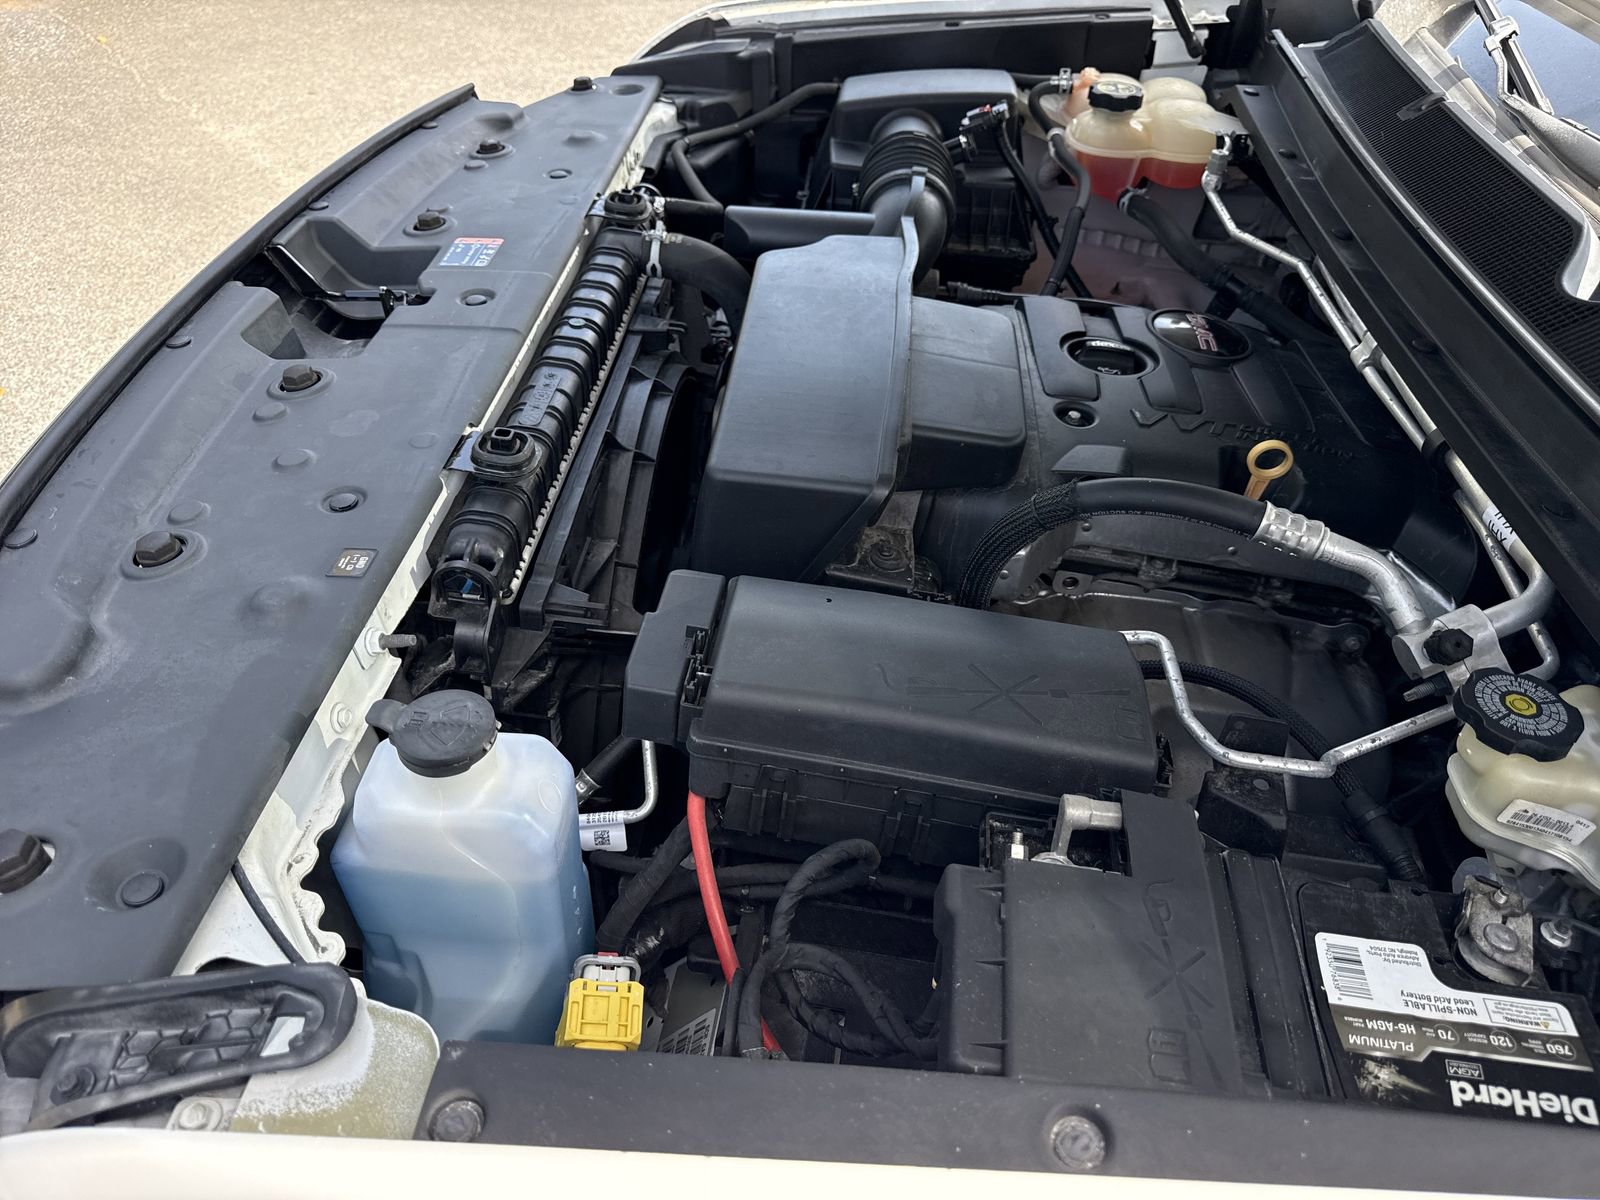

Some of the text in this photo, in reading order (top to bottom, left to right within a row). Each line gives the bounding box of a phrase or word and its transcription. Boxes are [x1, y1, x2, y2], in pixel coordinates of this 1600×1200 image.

[1400, 990, 1475, 1006] Lead Acid Battery
[1402, 998, 1478, 1016] NON-SPILLABLE
[1366, 1018, 1416, 1034] H6-AGM
[1348, 1034, 1415, 1052] PLATINUM
[1437, 1029, 1456, 1041] 70
[1490, 1034, 1513, 1048] 120
[1546, 1043, 1573, 1056] 760
[1449, 1066, 1479, 1077] AGM
[1450, 1080, 1600, 1126] DieHard
